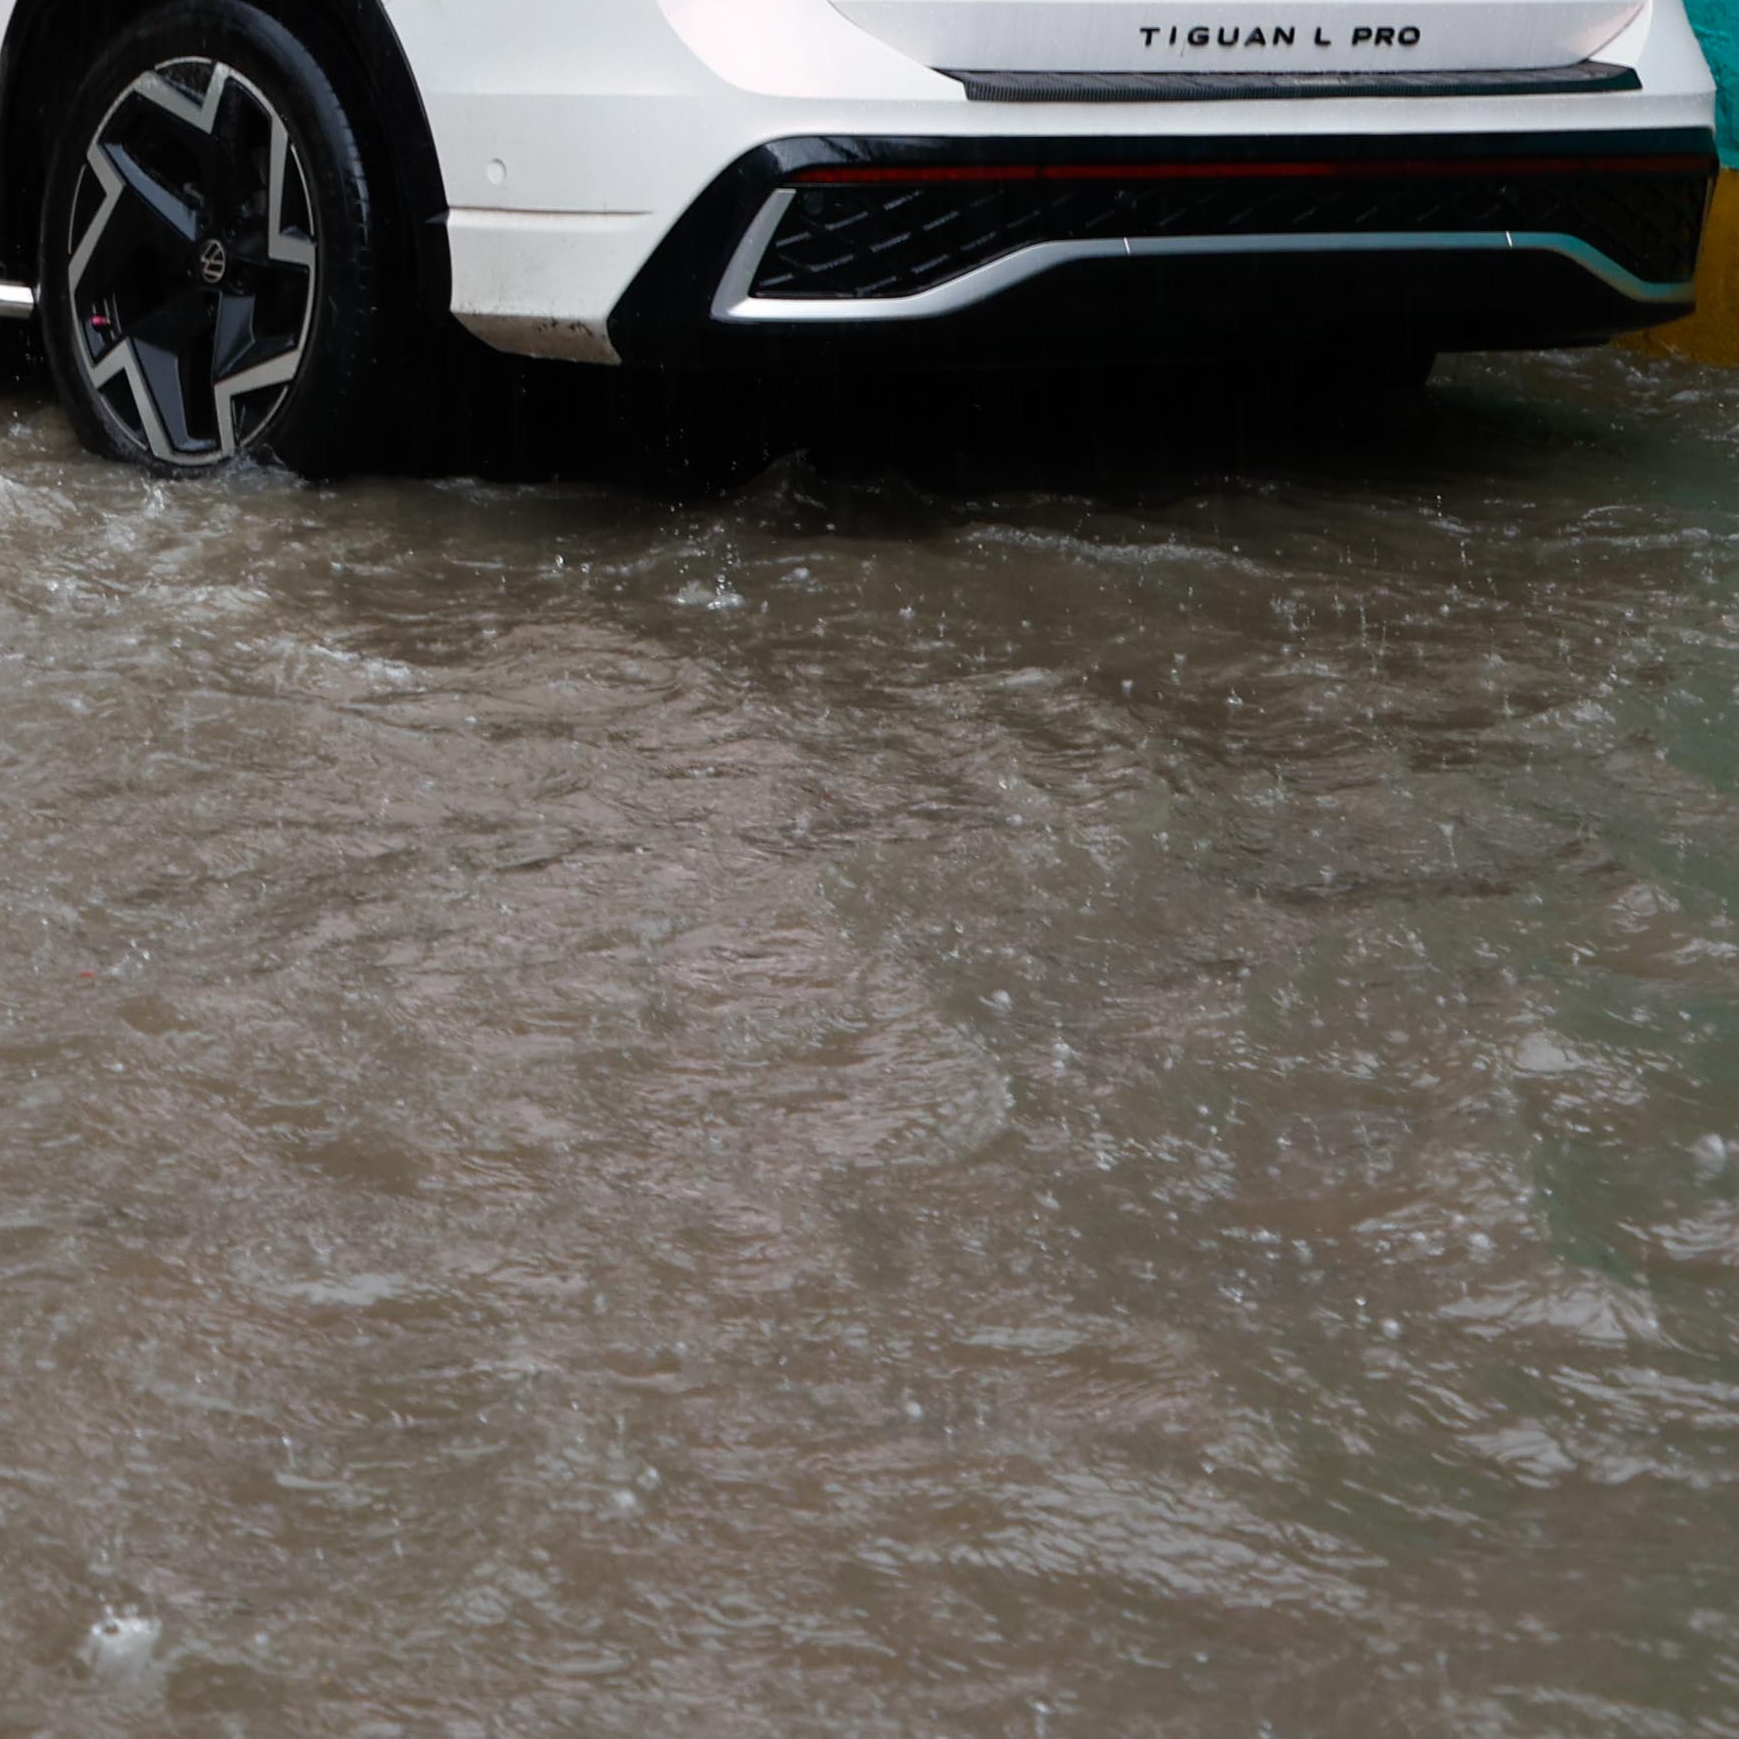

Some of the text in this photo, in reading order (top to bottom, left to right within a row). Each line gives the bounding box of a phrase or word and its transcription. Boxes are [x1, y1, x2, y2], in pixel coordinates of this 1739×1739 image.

[1139, 25, 1421, 48] TIGUAN L PRO
